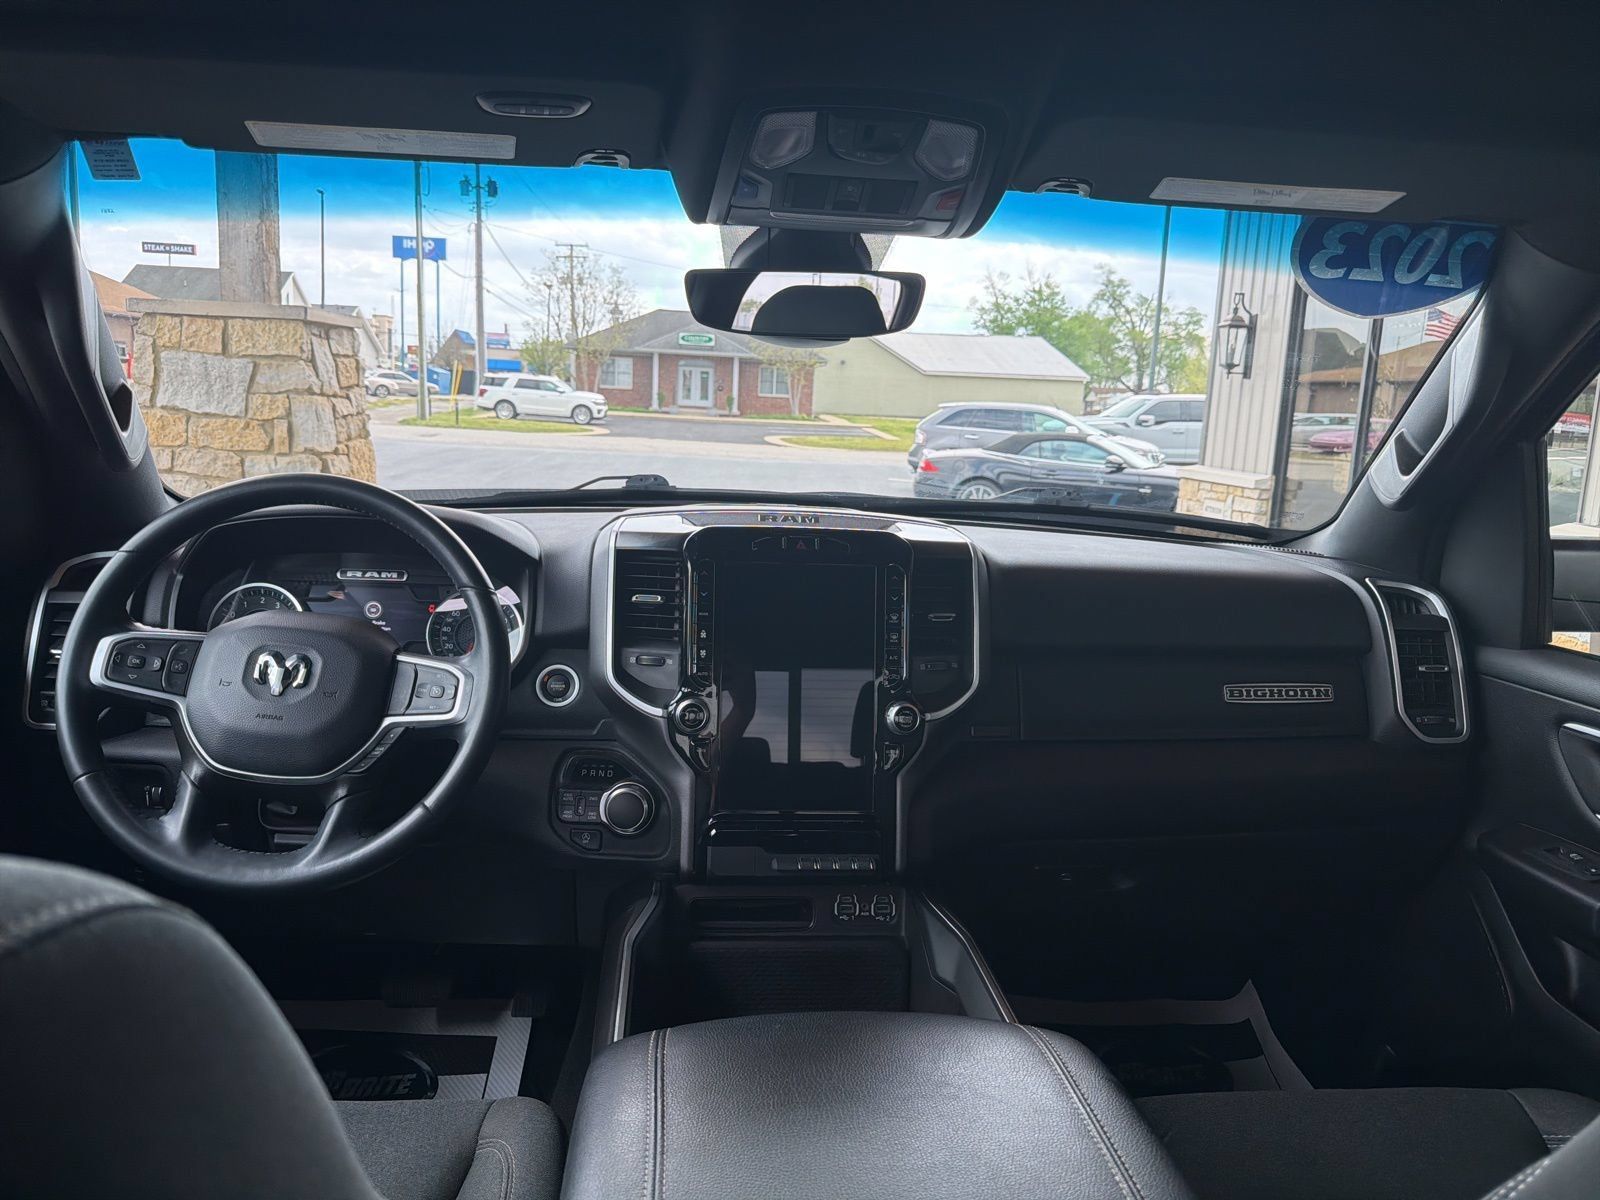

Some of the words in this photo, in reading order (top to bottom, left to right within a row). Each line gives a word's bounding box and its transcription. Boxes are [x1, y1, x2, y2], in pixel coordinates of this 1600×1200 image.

[144, 243, 165, 251] STEAK
[171, 245, 193, 253] SHAKE
[403, 238, 435, 253] IHP
[758, 514, 820, 524] RAM
[346, 570, 399, 579] RAM
[1227, 688, 1331, 698] BIGHORN
[255, 713, 284, 721] AIRBAG
[590, 769, 596, 777] R
[598, 769, 605, 777] N
